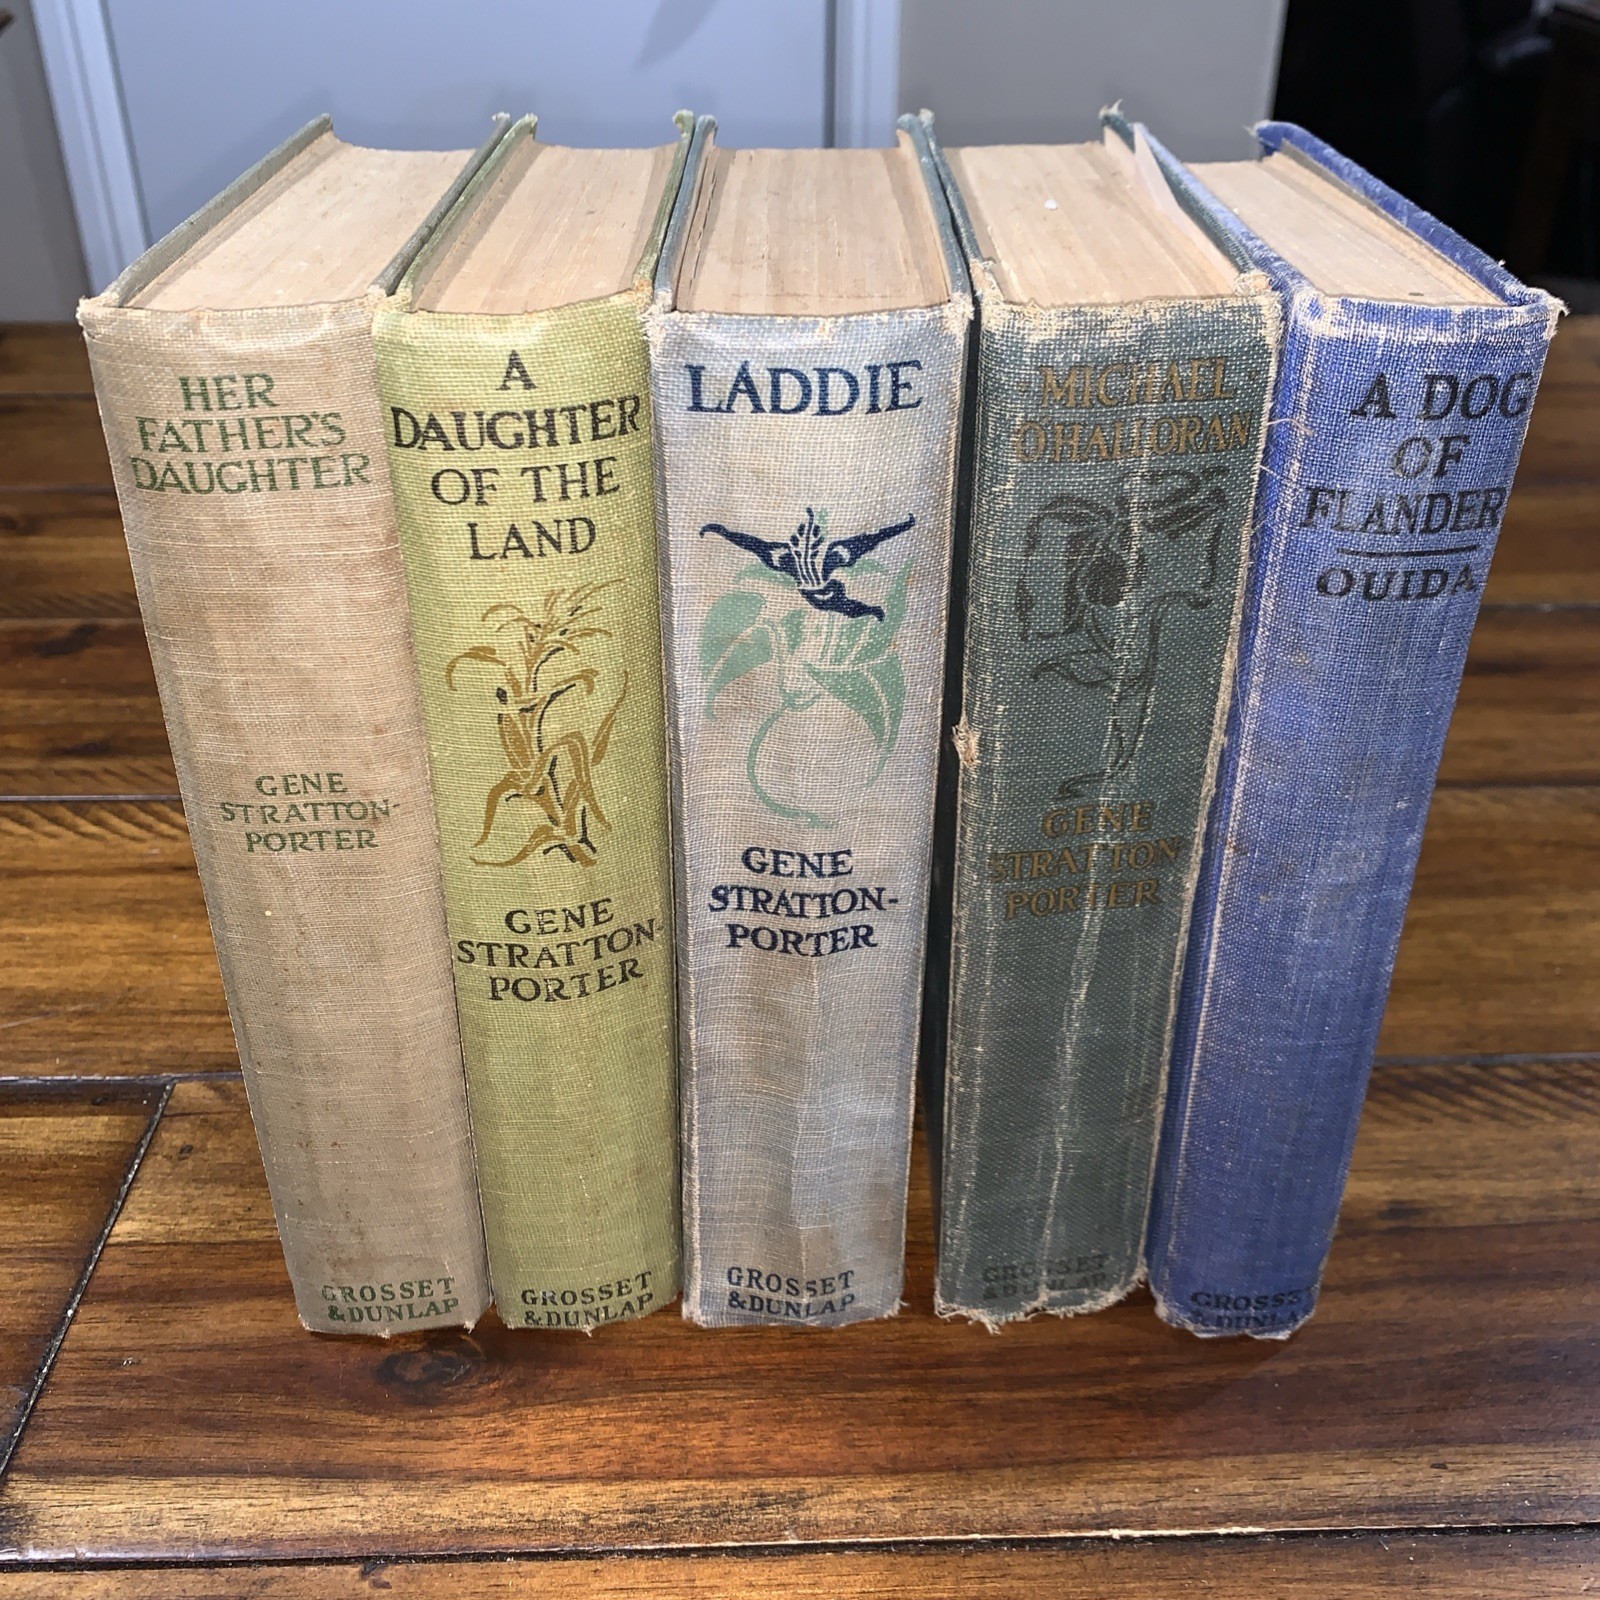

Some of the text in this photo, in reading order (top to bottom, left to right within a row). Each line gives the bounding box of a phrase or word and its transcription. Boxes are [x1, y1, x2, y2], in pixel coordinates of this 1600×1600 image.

[496, 350, 537, 391] A
[685, 360, 923, 416] LADDIE
[1039, 356, 1234, 408] MICHAEL
[178, 372, 281, 412] HER
[1350, 372, 1533, 420] A DOG
[135, 411, 346, 453] FATHER'S
[391, 395, 640, 451] DAUGHTER
[130, 453, 373, 494] DAUGHTER
[1391, 434, 1470, 479] OF
[431, 456, 620, 506] OF THE
[467, 517, 596, 560] LAND
[1316, 563, 1476, 599] OUIDA
[255, 772, 348, 796] GENE
[220, 799, 400, 824] STRATTON-
[1042, 800, 1153, 839] GENE
[245, 829, 379, 853] PORTER
[741, 846, 853, 879] GENE
[505, 897, 614, 936] GENE
[708, 884, 899, 919] STRATTON-
[1005, 878, 1162, 921] PORTER
[725, 923, 878, 958] PORTER
[489, 958, 644, 1003] PORTER
[727, 1266, 855, 1298] GROSSET
[983, 1253, 1111, 1283] GROSET
[321, 1277, 455, 1303] GROSSET
[520, 1271, 652, 1306] GROSSET
